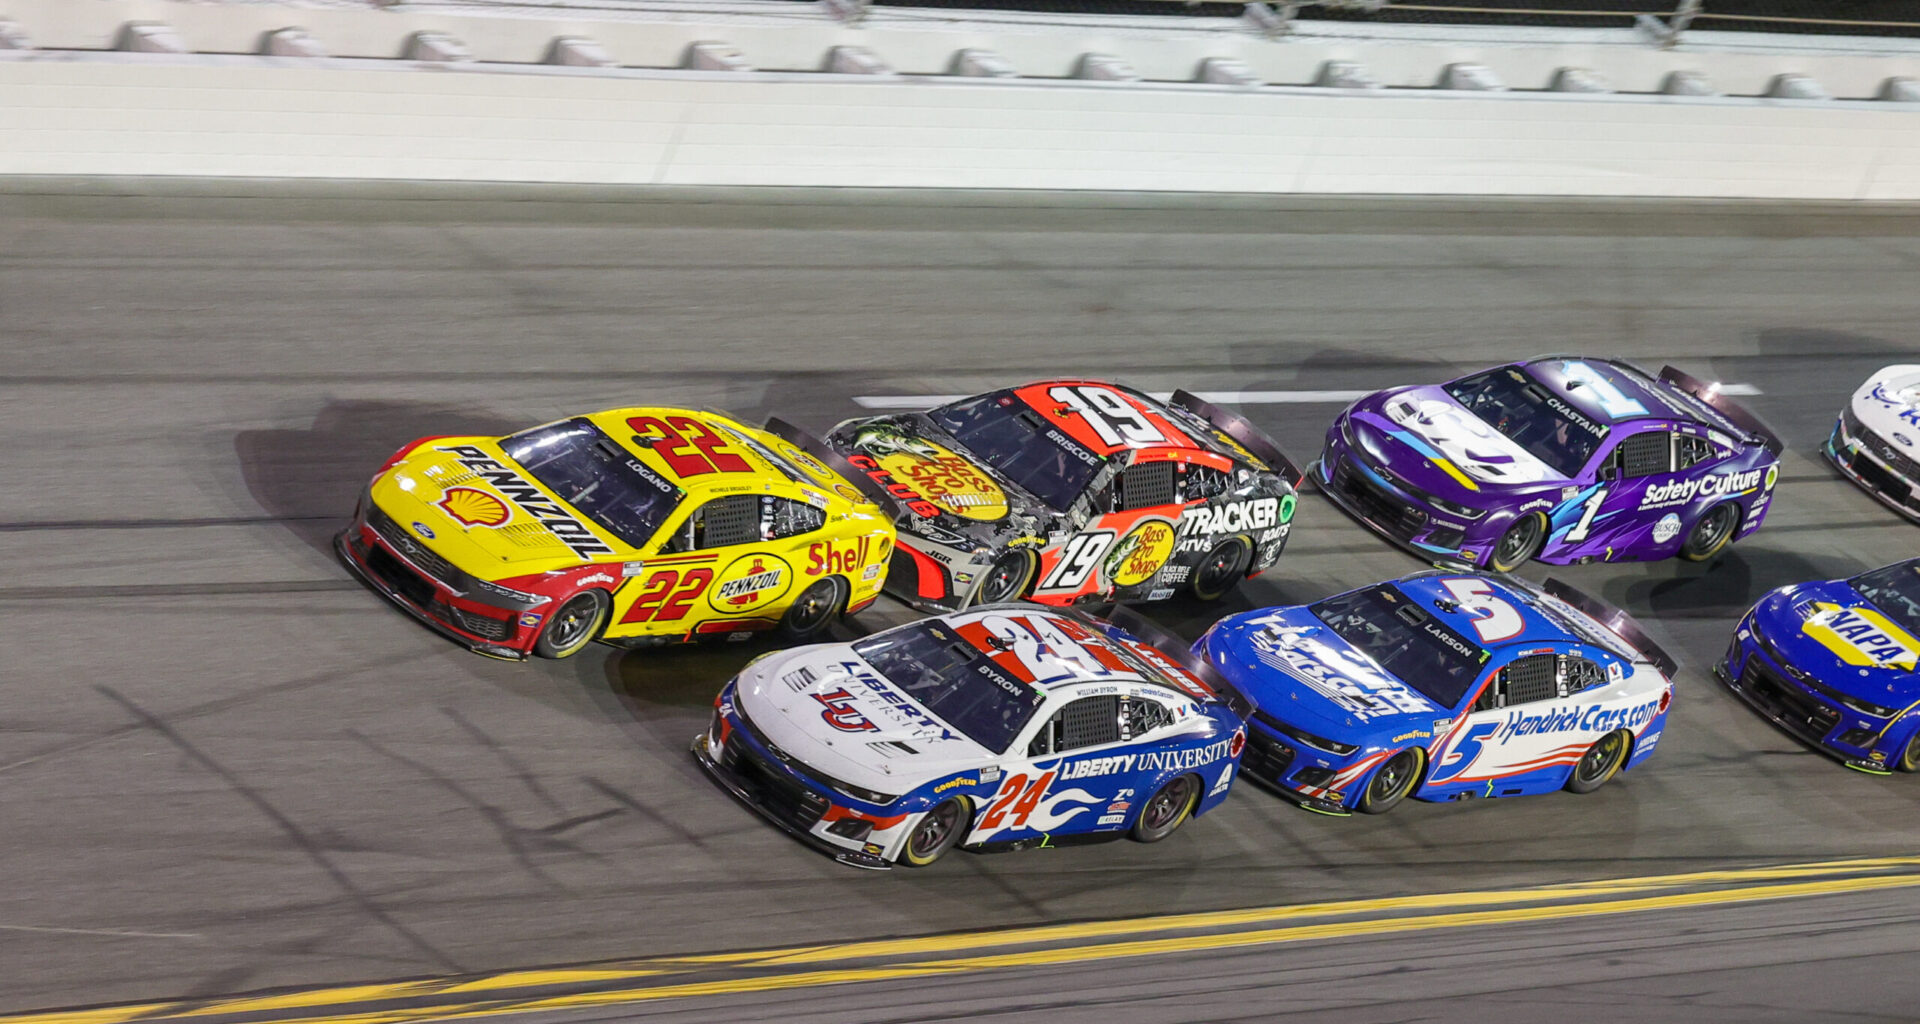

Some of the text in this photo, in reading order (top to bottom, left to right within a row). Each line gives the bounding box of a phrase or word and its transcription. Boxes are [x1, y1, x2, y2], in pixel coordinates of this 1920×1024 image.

[1562, 361, 1650, 418] 1
[1047, 386, 1167, 446] 19
[1546, 398, 1602, 439] CHASTAIN
[626, 416, 755, 479] 22
[1046, 430, 1099, 466] BRISCOE
[625, 459, 672, 493] LOGANO
[847, 455, 941, 518] CLUB
[917, 460, 965, 488] Pro
[934, 456, 996, 493] Bass
[1641, 469, 1762, 504] SafetyCulture
[434, 445, 614, 561] PENNZOIL
[1181, 497, 1278, 536] TRACKER
[1519, 498, 1553, 511] GOODYEAR
[1563, 487, 1609, 544] 1
[1008, 535, 1046, 547] GOODYEAR
[1131, 543, 1154, 558] Pro
[1138, 526, 1167, 544] Bass
[1260, 523, 1290, 544] BOATS
[805, 536, 870, 576] Shell
[925, 550, 952, 564] JGR
[1040, 532, 1114, 589] 19
[1125, 558, 1159, 578] Shops
[576, 572, 614, 586] GOODYEAR
[619, 567, 714, 625] 22
[716, 569, 781, 600] PENNZOIL
[1161, 573, 1188, 583] COFFEE
[1439, 578, 1526, 644] 5
[981, 614, 1111, 684] 24
[1424, 623, 1473, 657] LARSON
[1824, 610, 1906, 661] NAPA
[977, 665, 1023, 697] BYRON
[1077, 686, 1118, 696] WILLIAM BYRON
[718, 703, 734, 719] 24
[840, 661, 963, 741] LIBERTY
[1392, 729, 1430, 743] GOODYEAR
[1430, 719, 1504, 784] 5
[1060, 738, 1233, 780] LIBERTY UNIVERSITY
[934, 777, 977, 793] GOODYEAR
[978, 770, 1056, 831] 24
